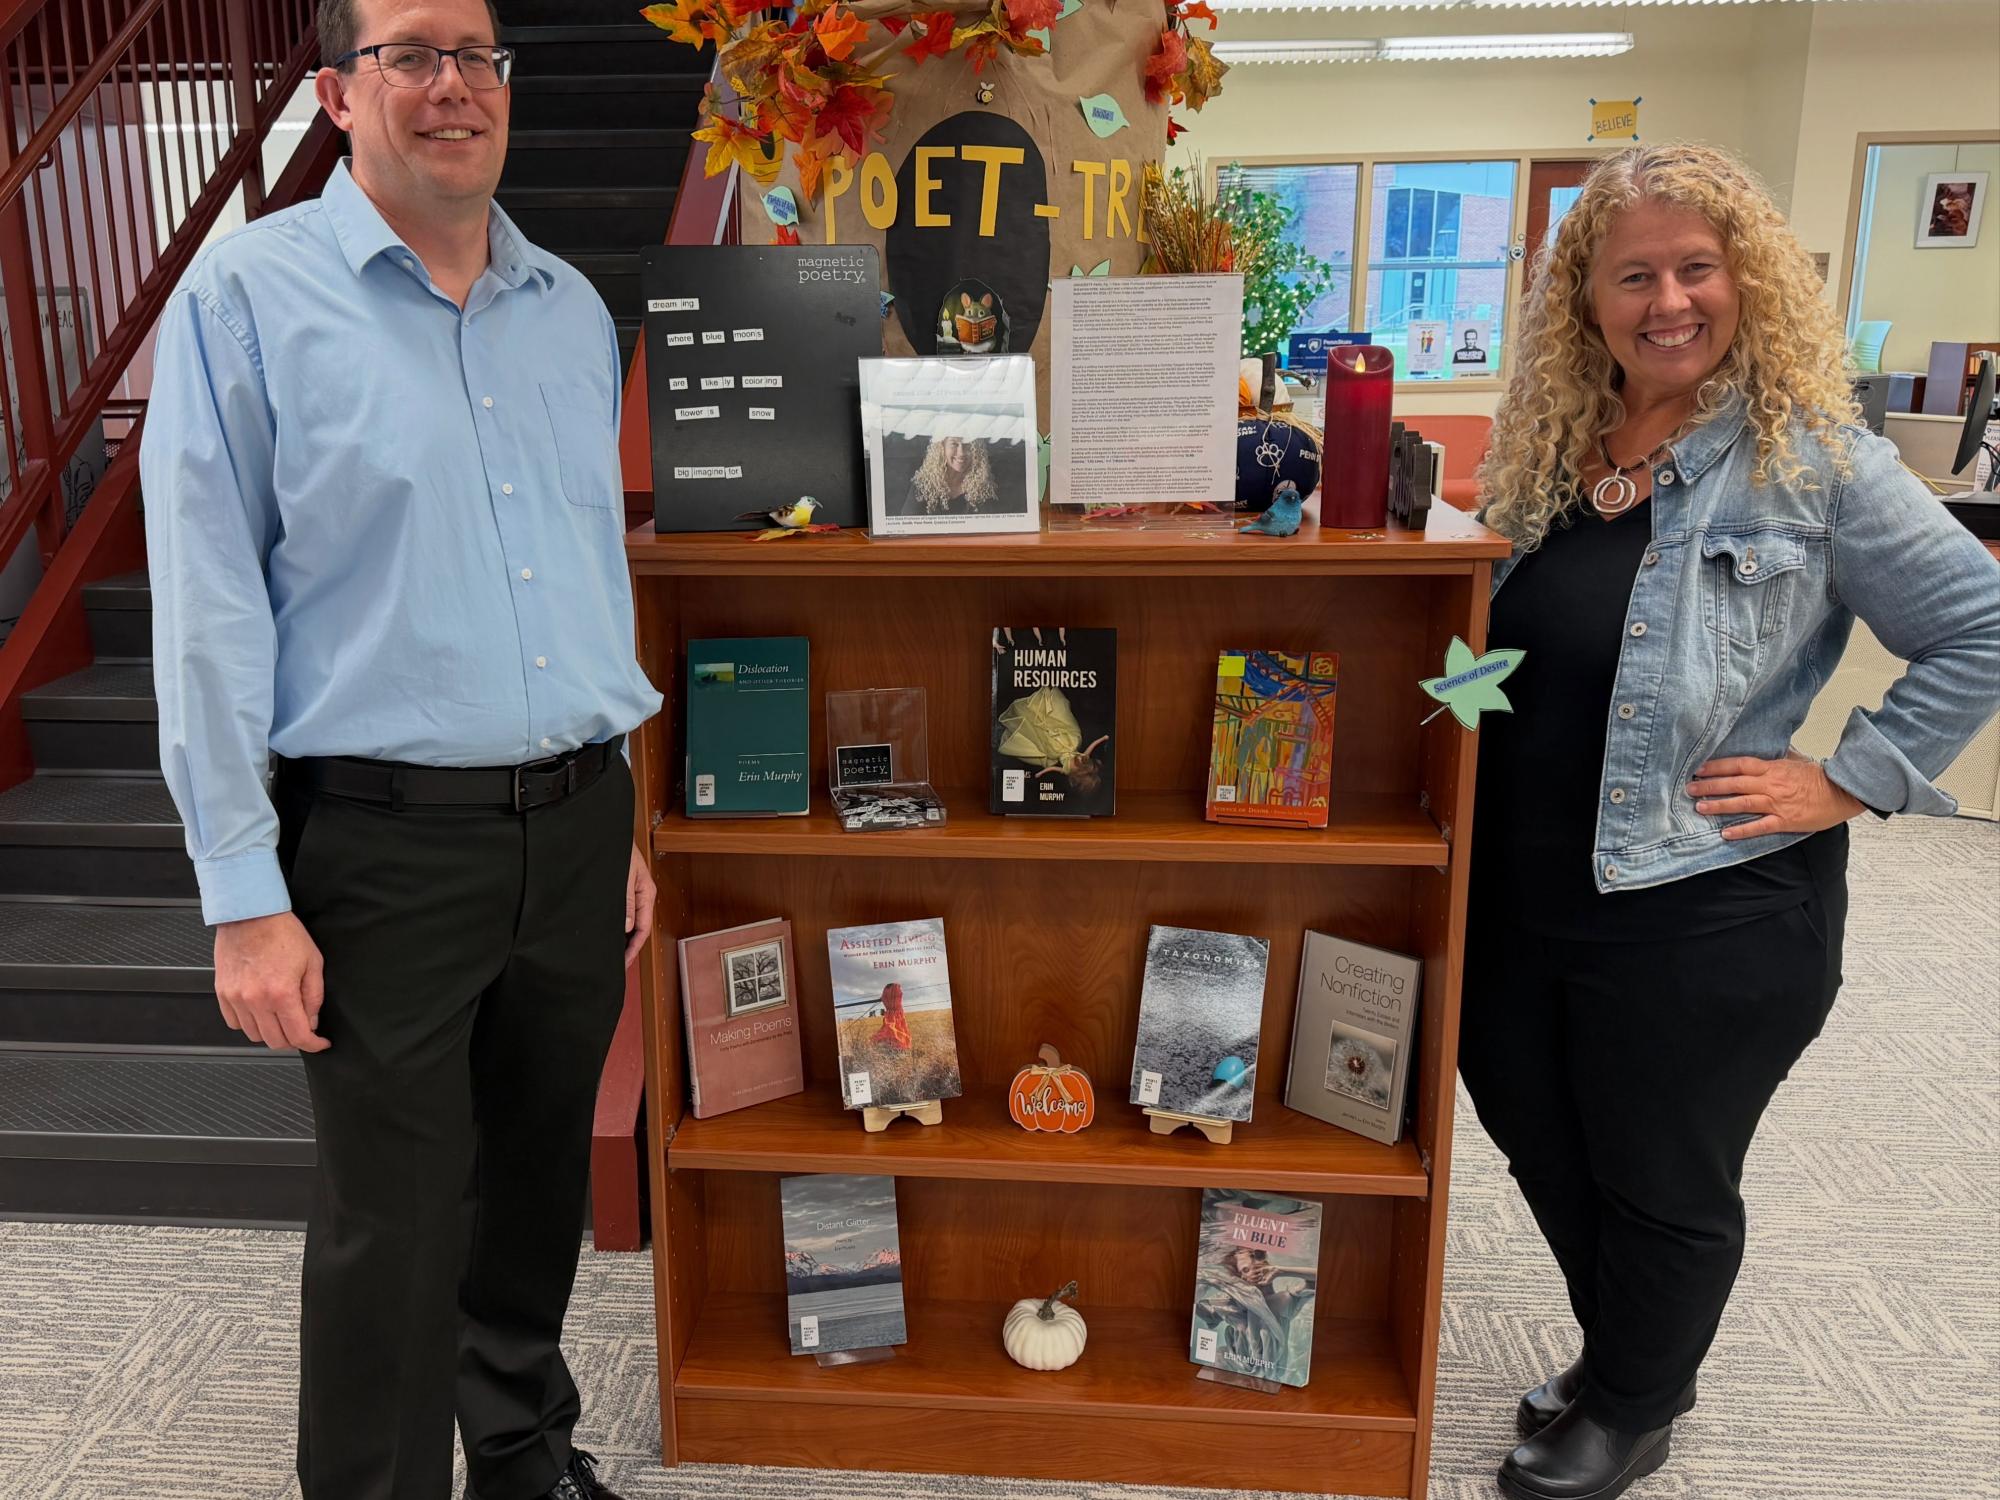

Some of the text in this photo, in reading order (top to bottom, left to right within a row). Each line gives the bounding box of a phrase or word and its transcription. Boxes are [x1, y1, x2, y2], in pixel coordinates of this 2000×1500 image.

[1595, 113, 1633, 135] BELIEVE
[798, 256, 864, 269] magnetic
[668, 334, 693, 343] where
[705, 332, 722, 341] blue
[672, 379, 686, 388] are
[677, 467, 739, 478] big imagine for
[1014, 649, 1067, 668] HUMAN
[738, 663, 789, 674] Dislocation
[1433, 659, 1509, 694] Science of Desire
[1013, 670, 1097, 688] RESOURCES
[842, 756, 888, 765] magnetic
[739, 770, 802, 783] Erin Murphy
[843, 764, 888, 777] poetry
[1040, 782, 1054, 791] ERIN
[1040, 792, 1064, 801] MURPHY
[840, 933, 936, 950] ASSISTED LIVING
[873, 956, 937, 970] ERIN MURPHY
[1162, 948, 1261, 968] TAXONOMIES
[1335, 956, 1405, 995] Creating
[1320, 972, 1402, 1012] Nonfiction
[710, 1017, 792, 1045] Making Poems
[1016, 1086, 1087, 1117] Welcome
[817, 1217, 872, 1231] Distant Glitter
[1233, 1212, 1289, 1233] FLUENT
[1232, 1227, 1287, 1249] IN BLUE
[1224, 1351, 1274, 1369] ERIN MURPHY
